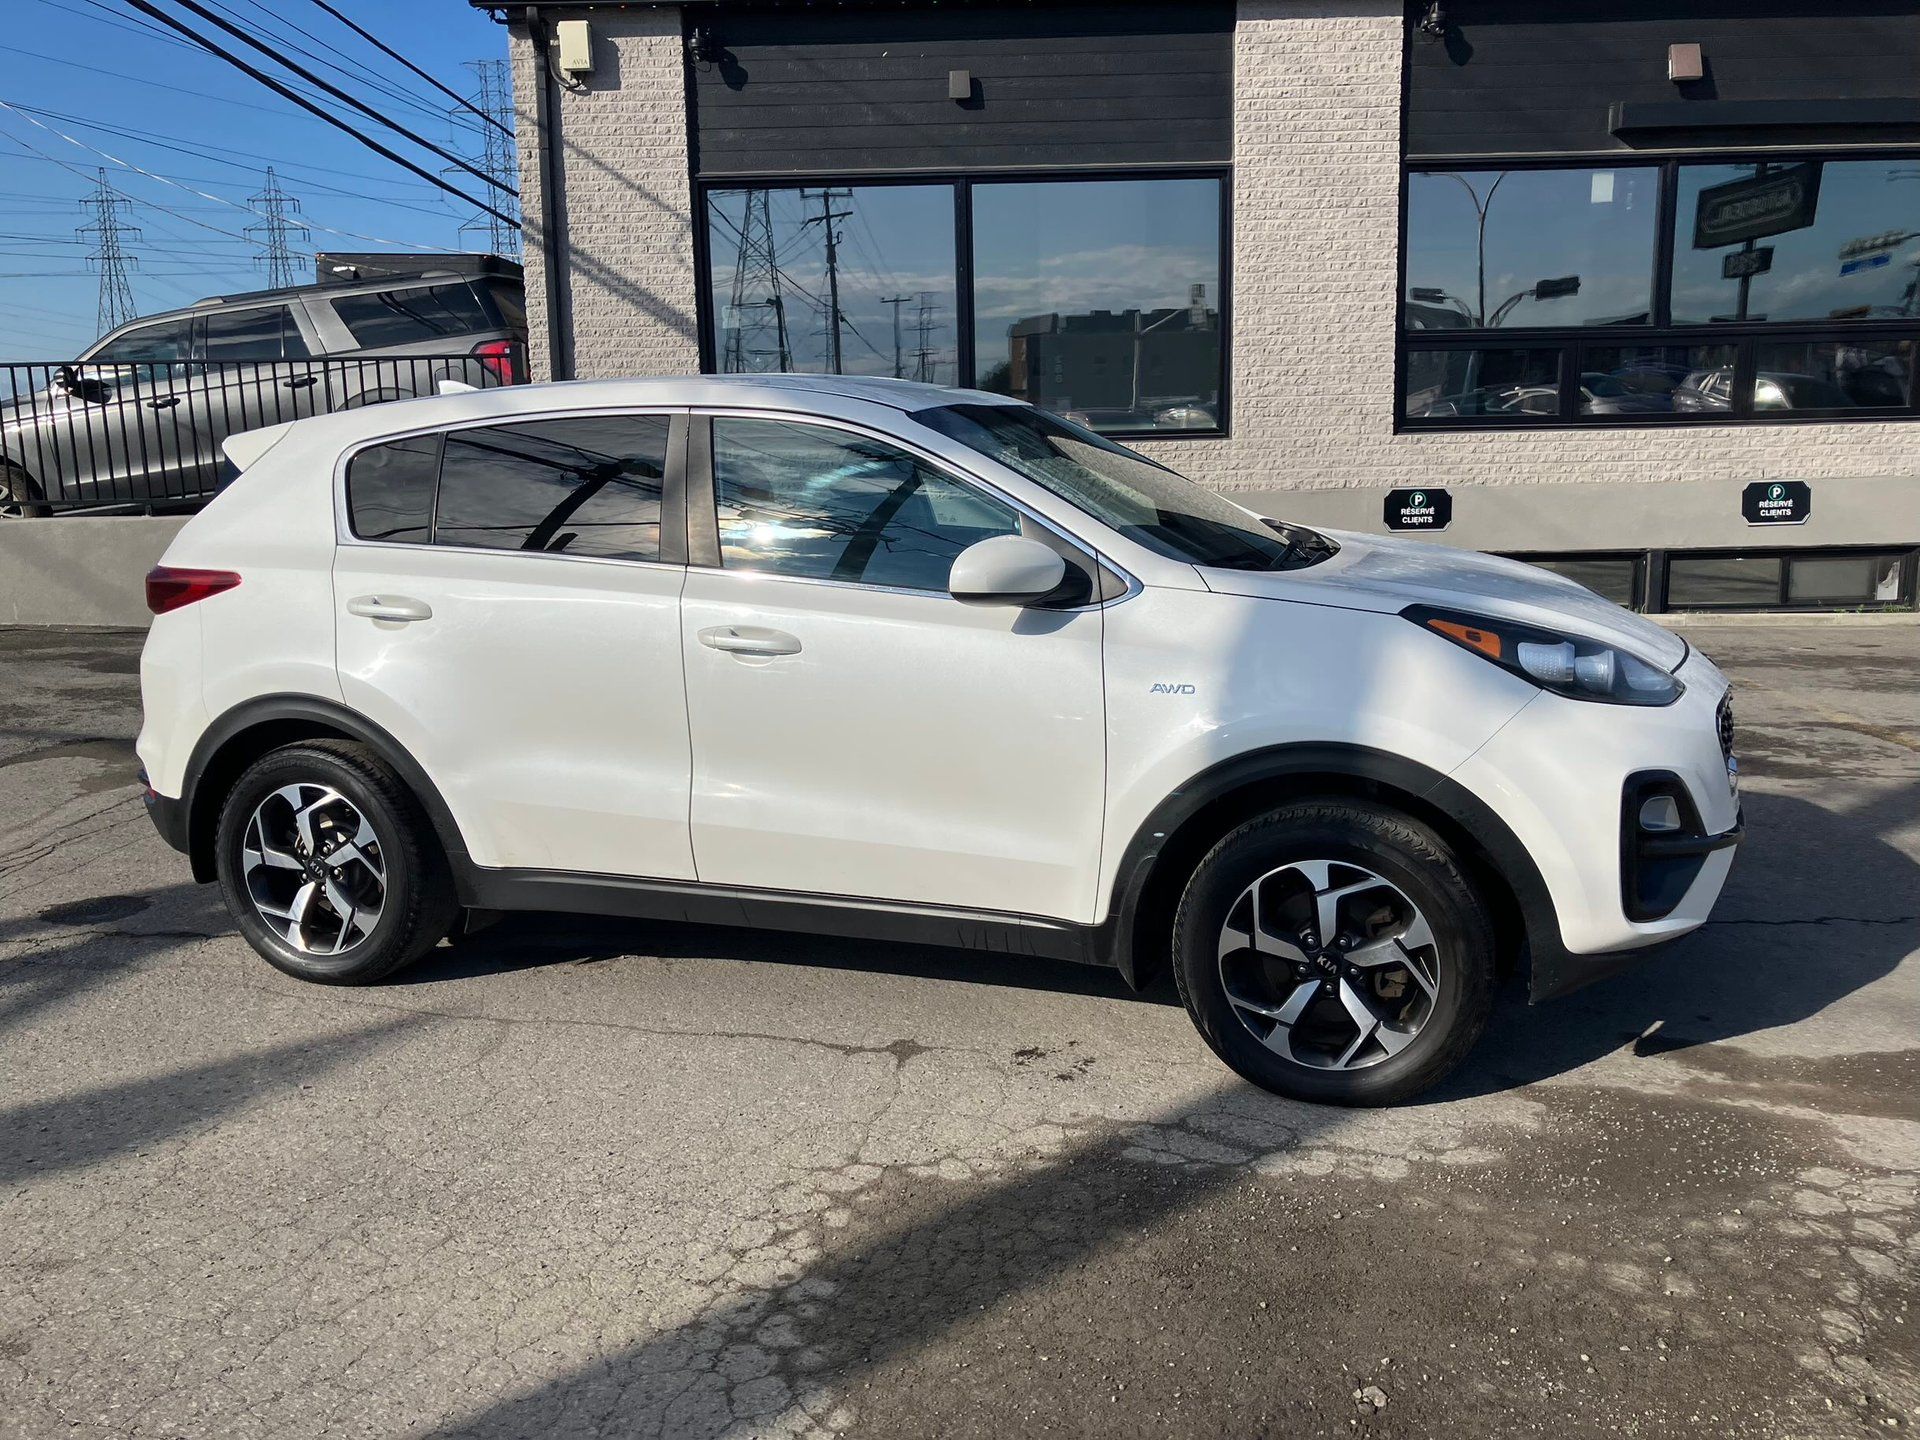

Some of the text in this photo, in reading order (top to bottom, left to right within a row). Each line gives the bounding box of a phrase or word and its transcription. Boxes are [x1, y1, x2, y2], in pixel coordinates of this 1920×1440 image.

[1772, 487, 1782, 498] P
[1414, 494, 1424, 506] P
[1758, 499, 1794, 508] RÉSERVÉ
[1400, 506, 1435, 515] RÉSERVÉ
[1760, 508, 1792, 517] CLIENTS
[1402, 516, 1433, 524] CLIENTS
[1150, 683, 1196, 695] AWD
[310, 861, 324, 878] KIA
[1316, 954, 1338, 975] KIA
